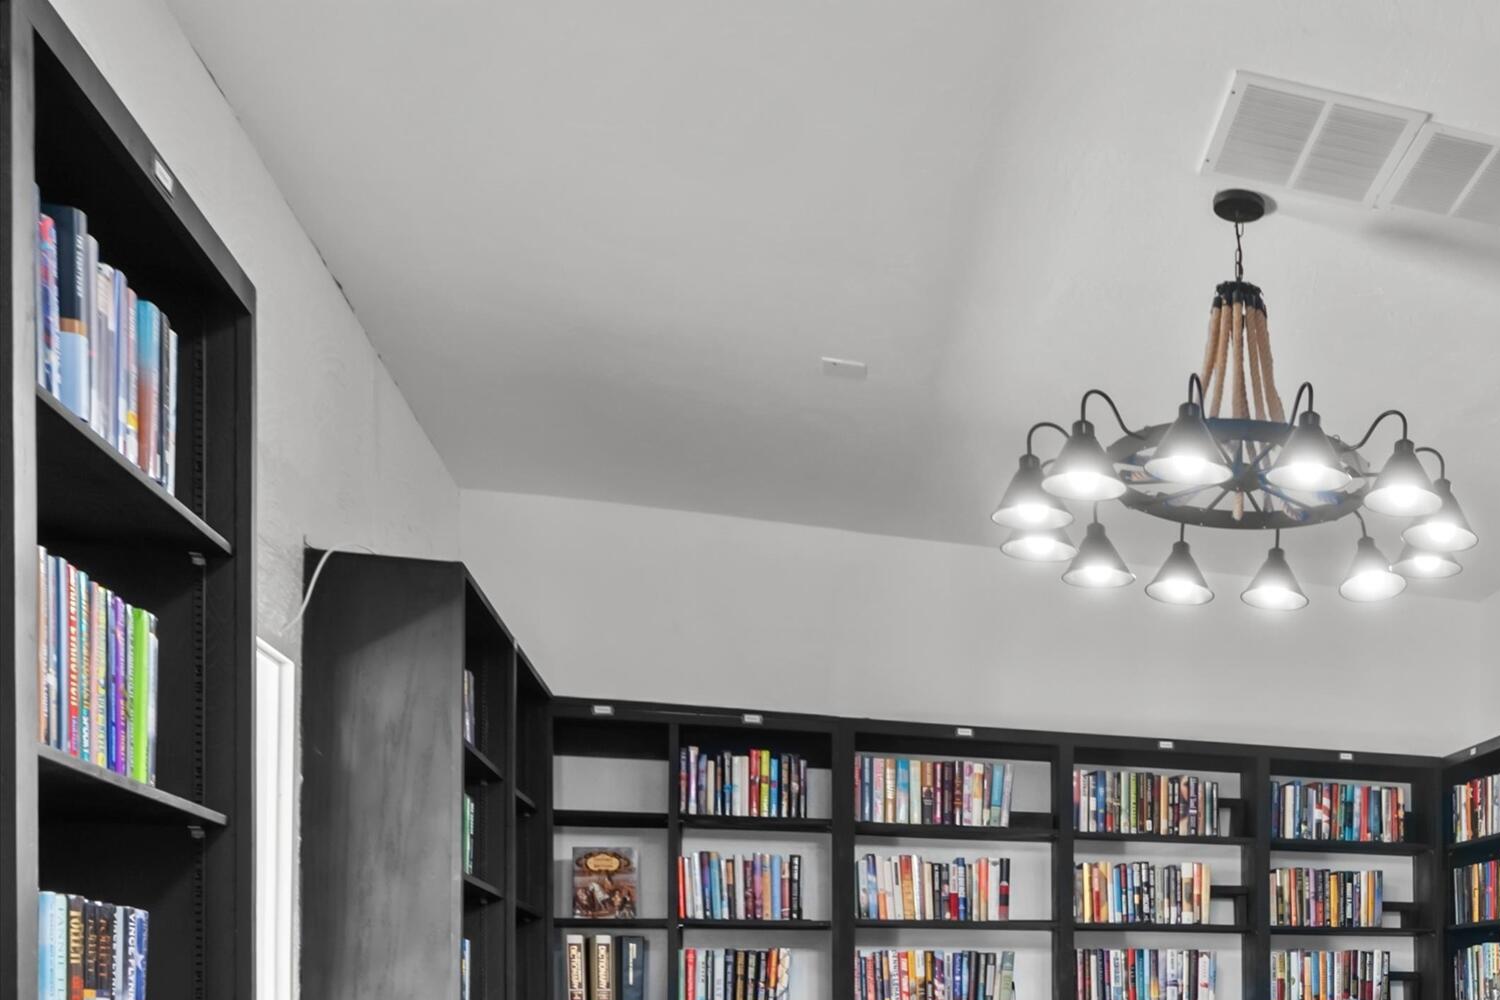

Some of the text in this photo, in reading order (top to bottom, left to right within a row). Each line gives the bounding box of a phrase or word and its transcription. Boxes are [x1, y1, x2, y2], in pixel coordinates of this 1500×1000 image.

[128, 914, 136, 957] VINCE
[570, 945, 578, 988] DICTIONARY
[598, 945, 607, 989] DICTIONARY
